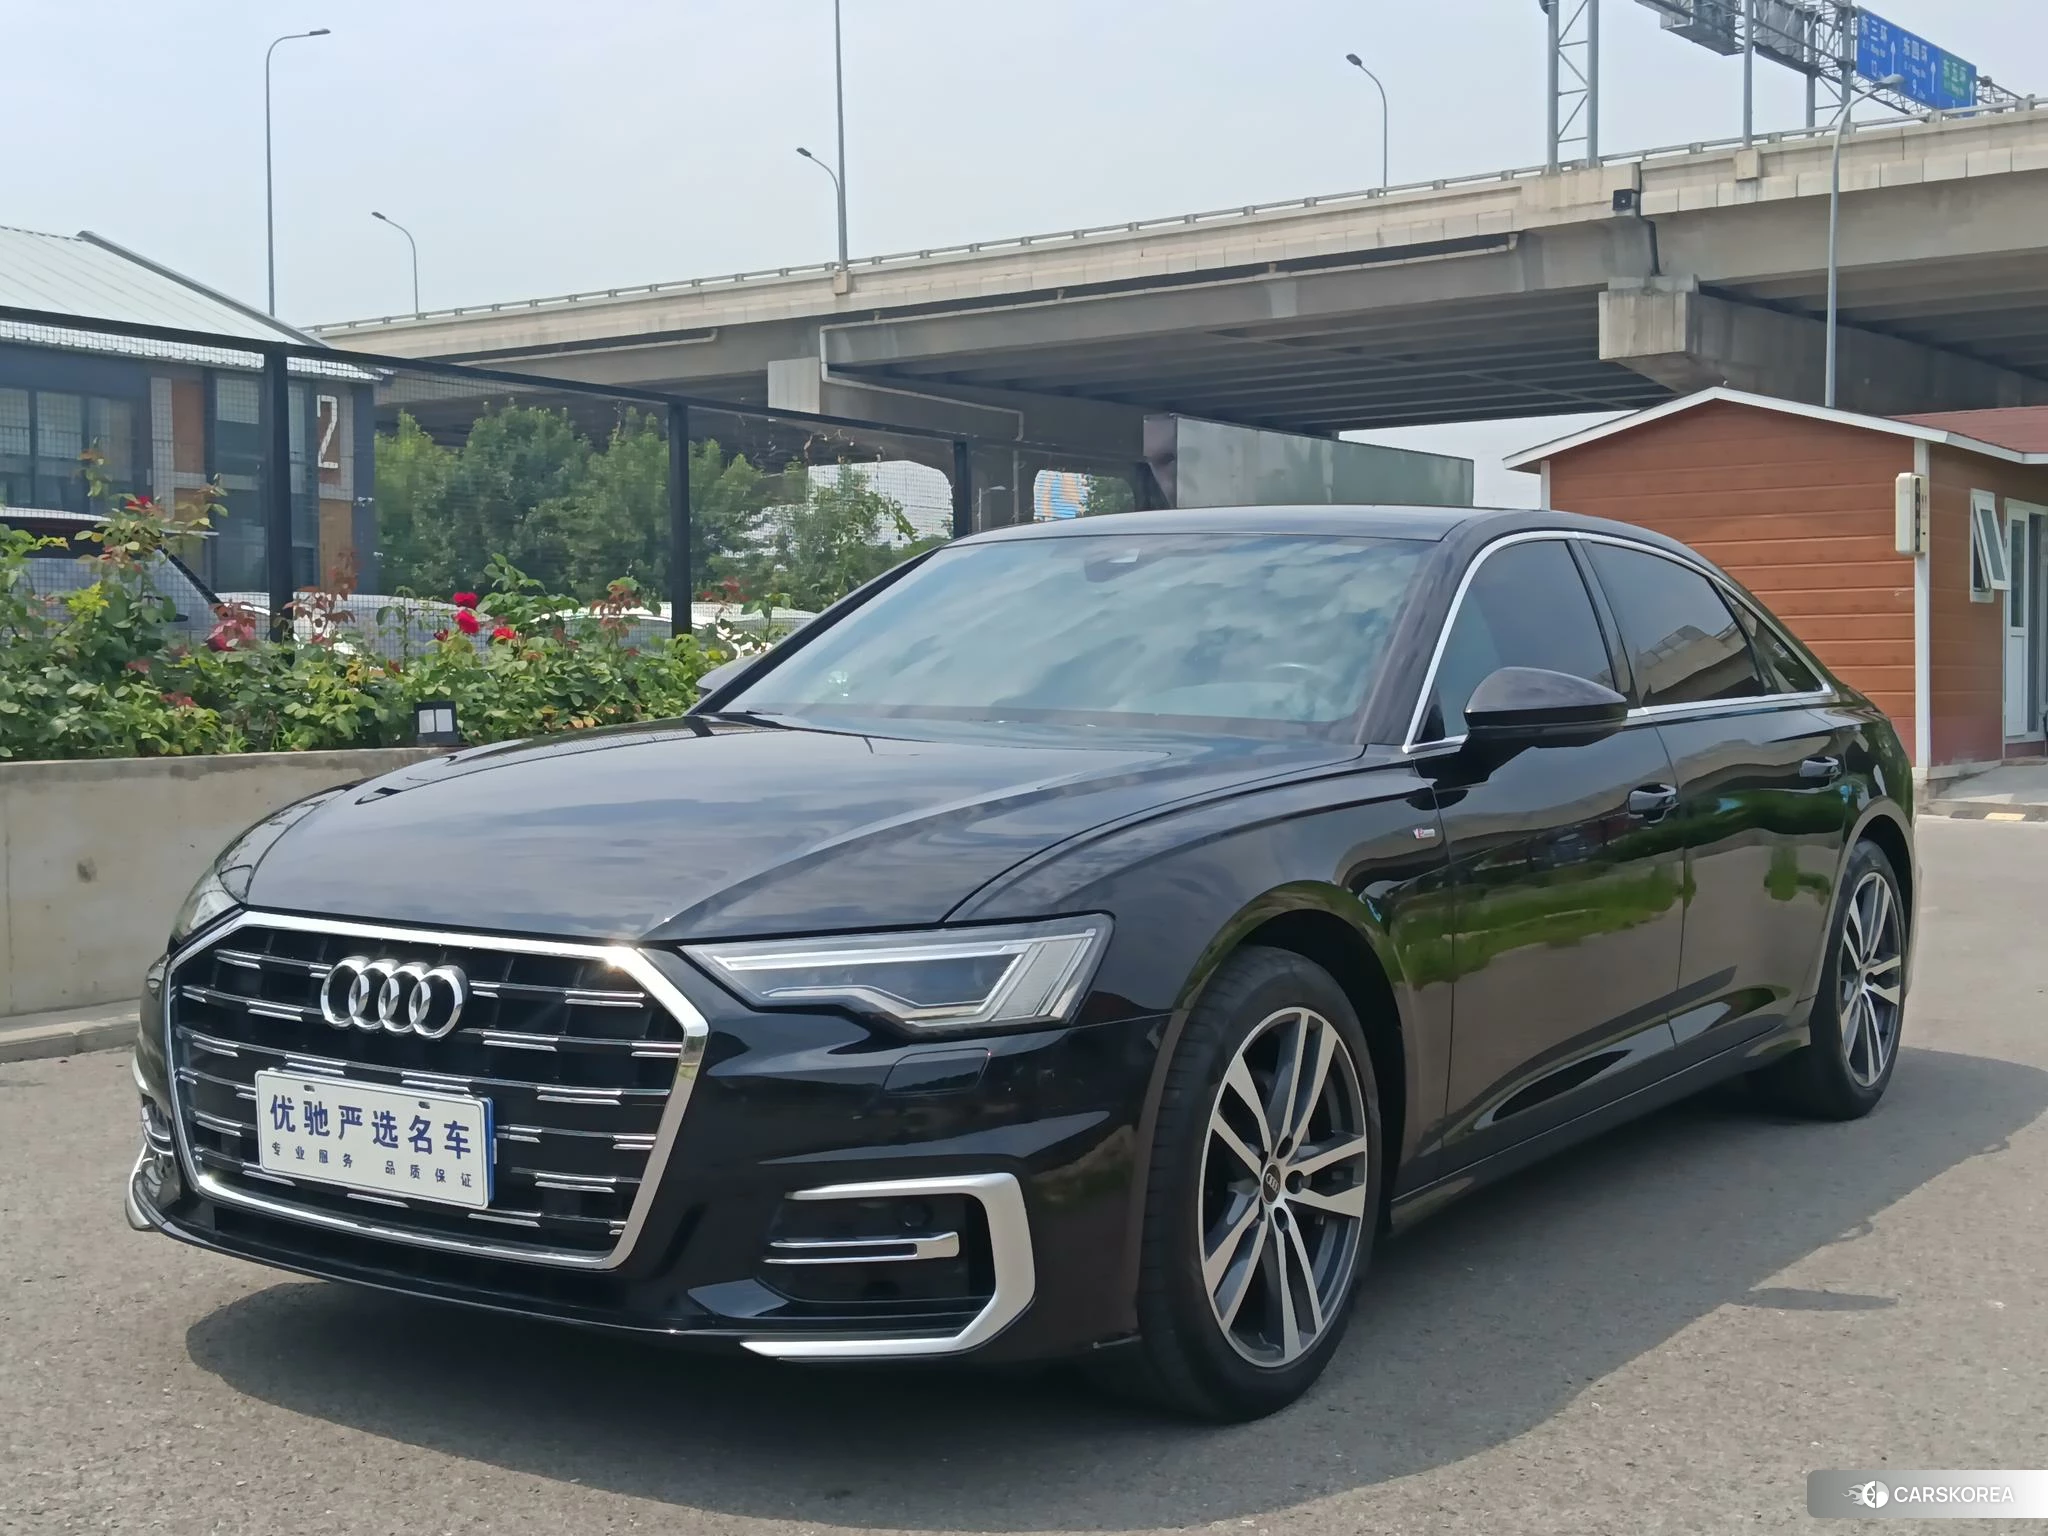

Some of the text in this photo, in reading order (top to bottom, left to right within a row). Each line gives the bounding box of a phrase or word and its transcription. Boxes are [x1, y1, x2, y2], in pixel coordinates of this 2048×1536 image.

[316, 394, 339, 469] 2
[270, 1094, 472, 1160] 优驰严选名车
[271, 1142, 473, 1188] 专业服务 品质保证
